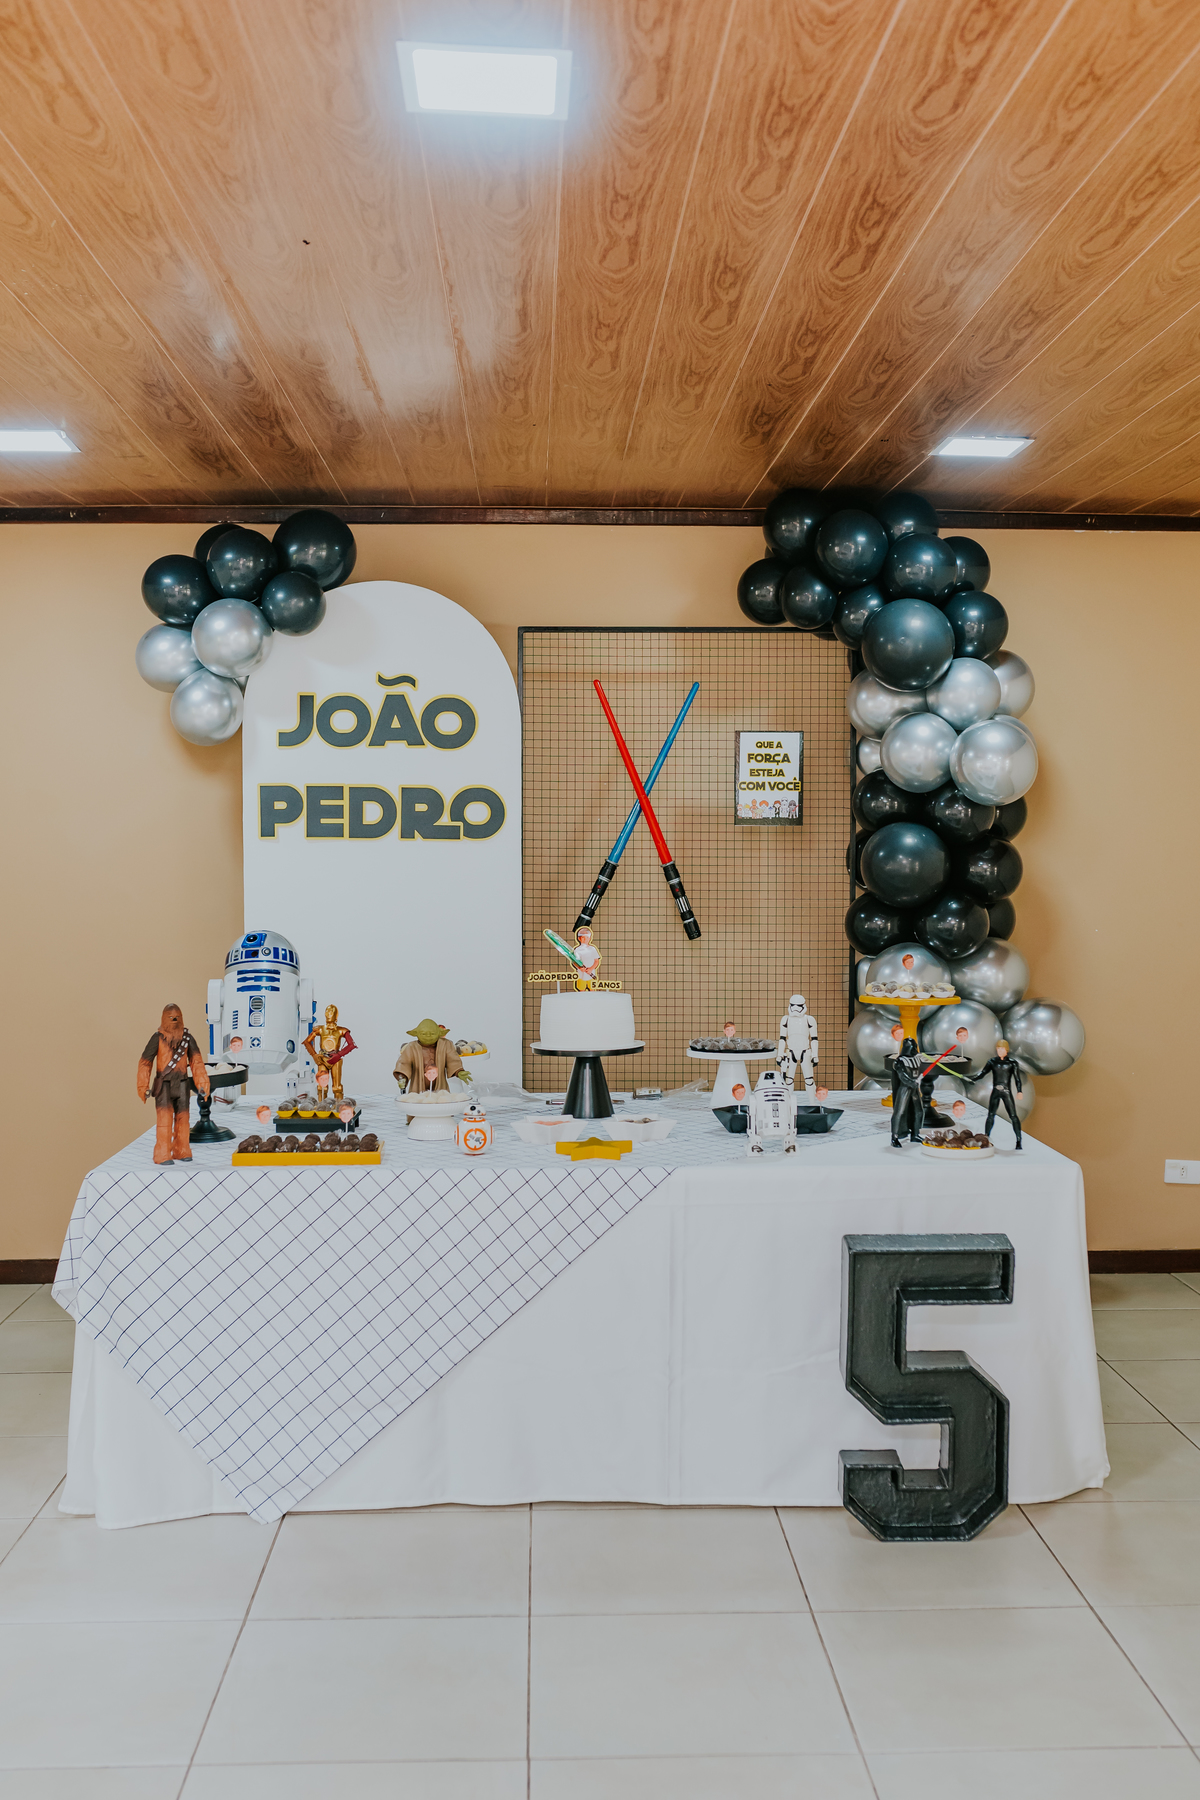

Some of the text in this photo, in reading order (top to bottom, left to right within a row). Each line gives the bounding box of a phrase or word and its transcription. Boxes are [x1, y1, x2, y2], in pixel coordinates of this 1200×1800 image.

[276, 671, 478, 750] JOÃO
[755, 741, 783, 749] QUE A
[747, 753, 791, 766] FORÇA
[749, 768, 785, 777] ESTEJA
[738, 776, 801, 792] COM VOCÊ
[257, 783, 507, 841] PEDRO
[591, 981, 621, 989] 5 ANOS
[838, 1233, 1015, 1542] 5
